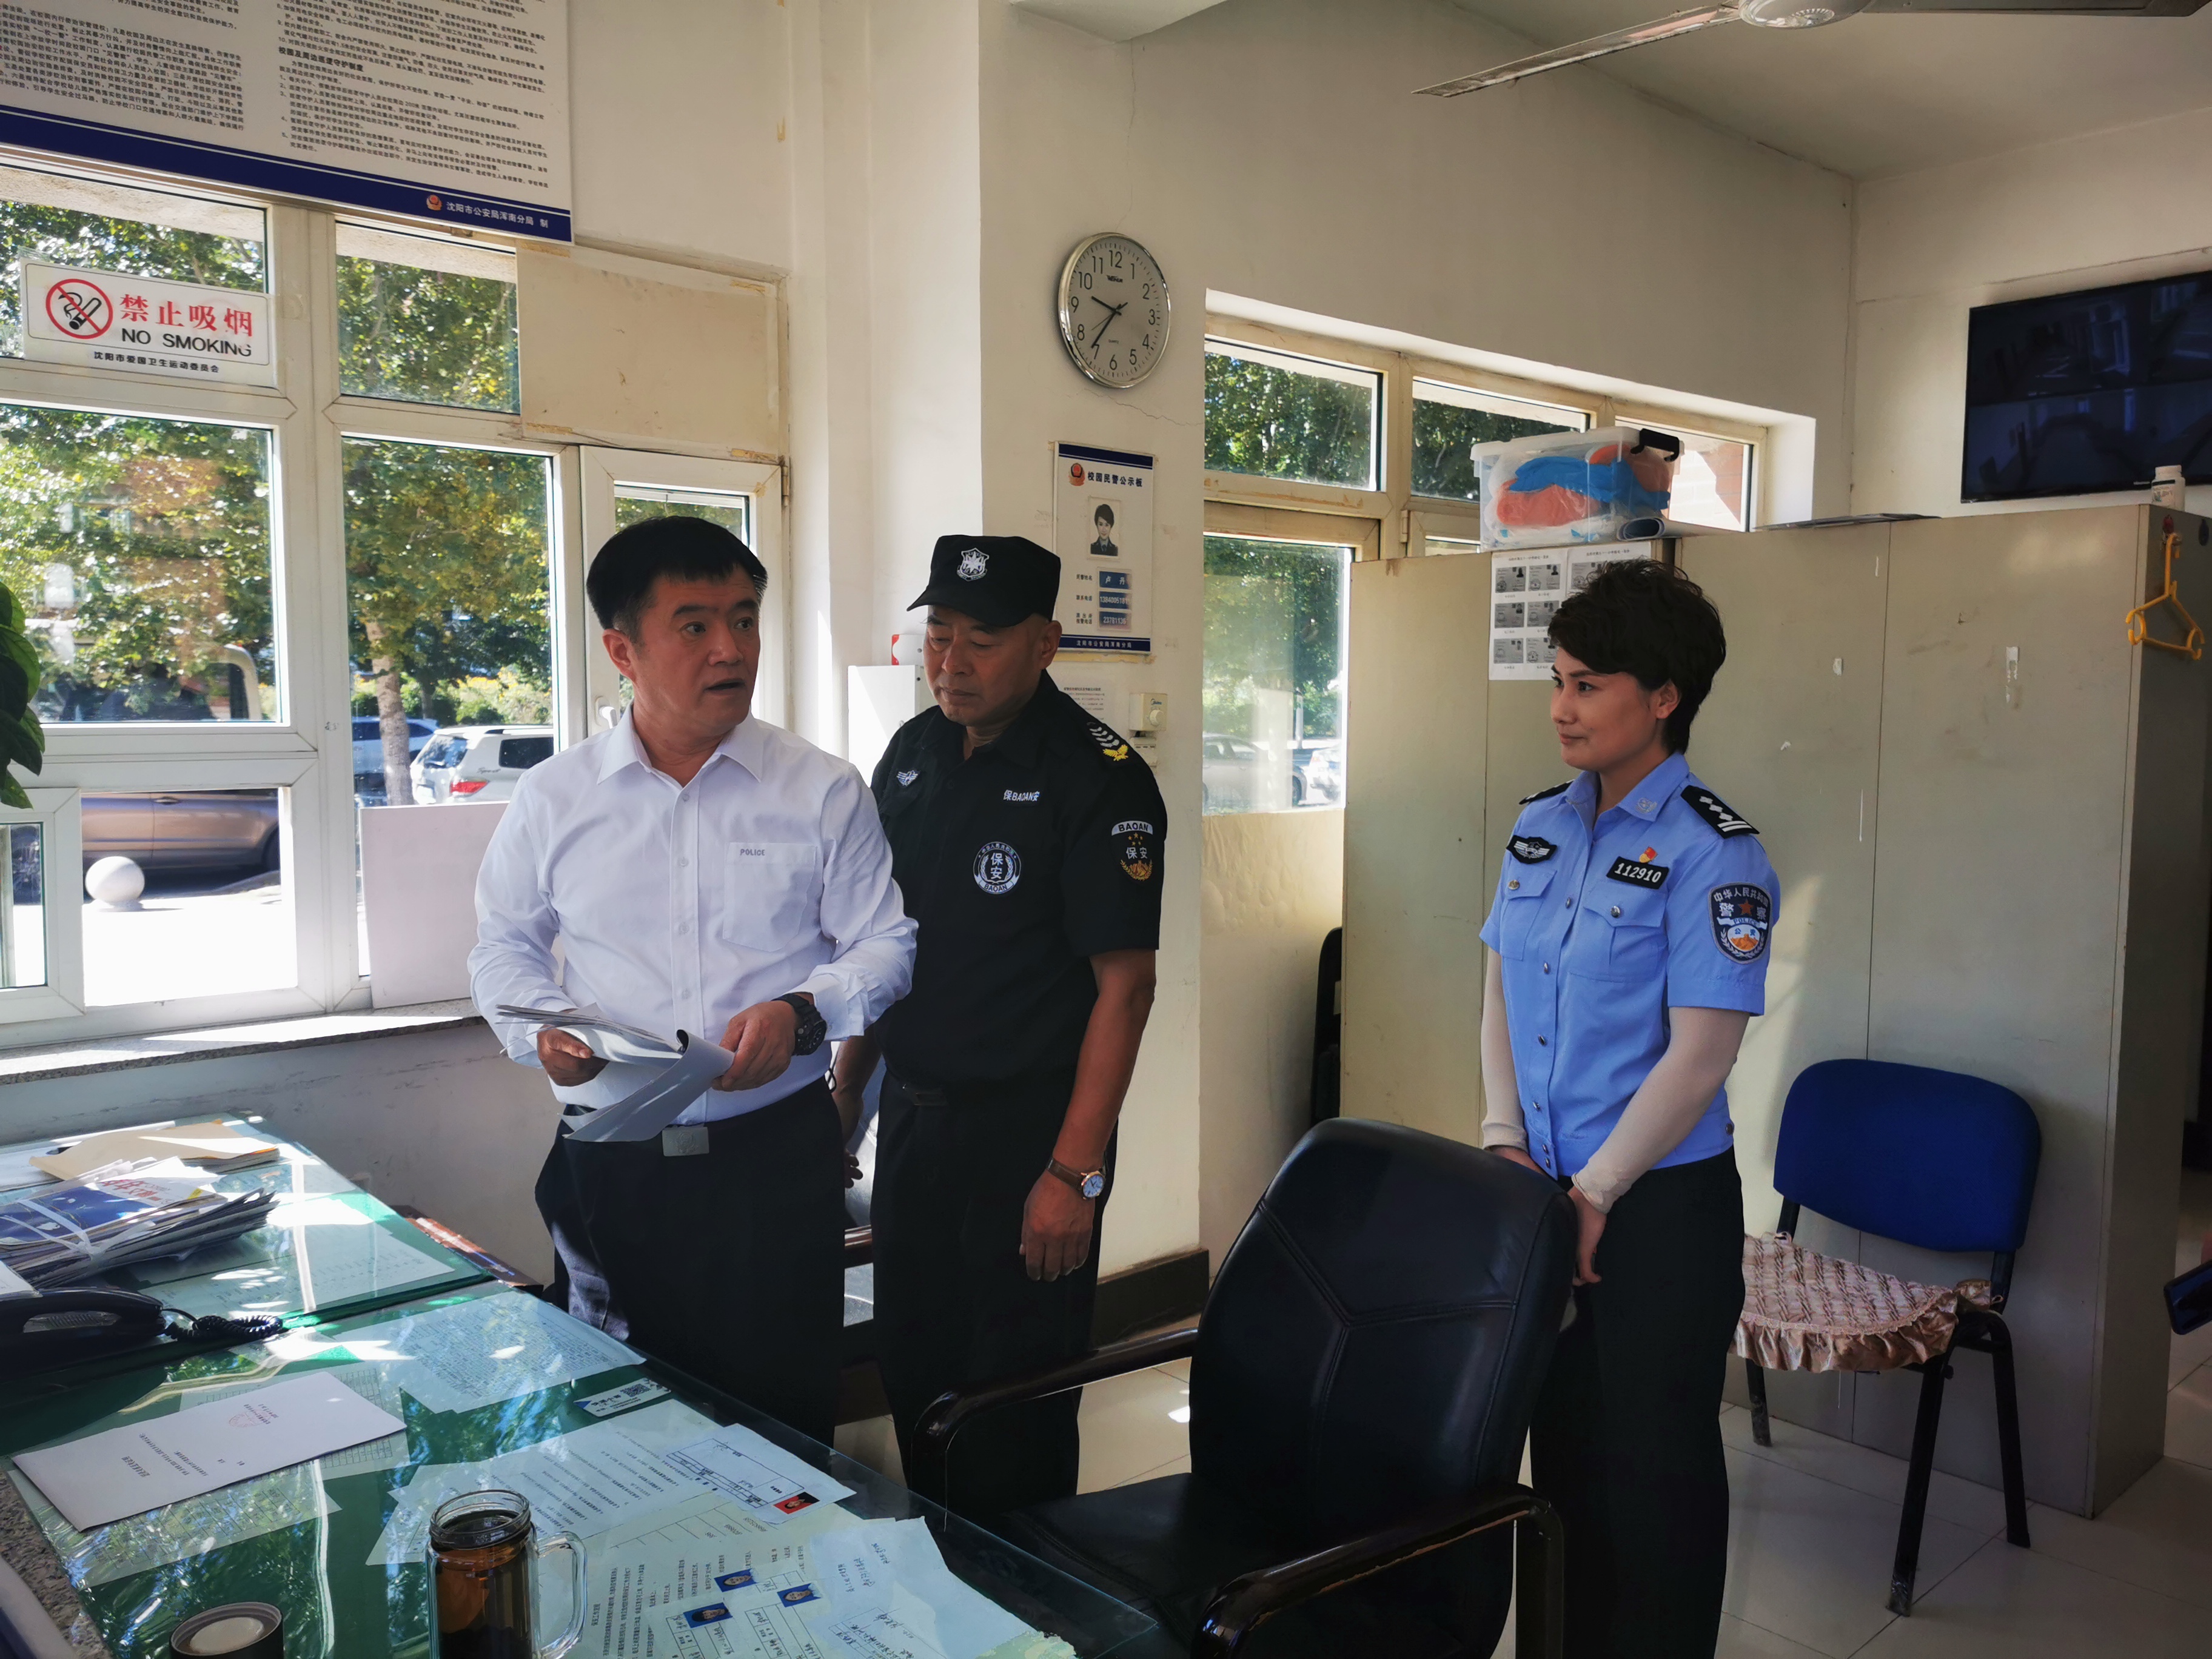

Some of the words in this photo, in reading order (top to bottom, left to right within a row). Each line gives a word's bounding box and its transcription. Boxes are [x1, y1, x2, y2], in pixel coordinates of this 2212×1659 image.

[447, 201, 534, 226] 沈阳市公安局浑南分局
[1092, 256, 1103, 274] 11
[1109, 250, 1122, 269] 12
[1130, 263, 1135, 280] 1
[1079, 271, 1093, 290] 10
[1142, 283, 1149, 300] 2
[1070, 297, 1079, 313] 9
[120, 293, 253, 337] 禁止吸烟
[1148, 309, 1156, 325] 3
[1077, 324, 1085, 341] 8
[122, 327, 151, 345] NO
[163, 334, 252, 357] SMOKING
[1142, 333, 1149, 350] 4
[1093, 343, 1100, 360] 7
[1129, 349, 1137, 366] 5
[93, 351, 220, 374] 沈阳市爱国卫生运动委员会
[1109, 354, 1117, 370] 6
[1087, 471, 1143, 487] 校园民警公示板
[1118, 822, 1149, 832] BAOAN
[1614, 862, 1662, 883] 112910
[984, 883, 1008, 892] BAOAN
[1713, 886, 1769, 907] 中华人民共和国
